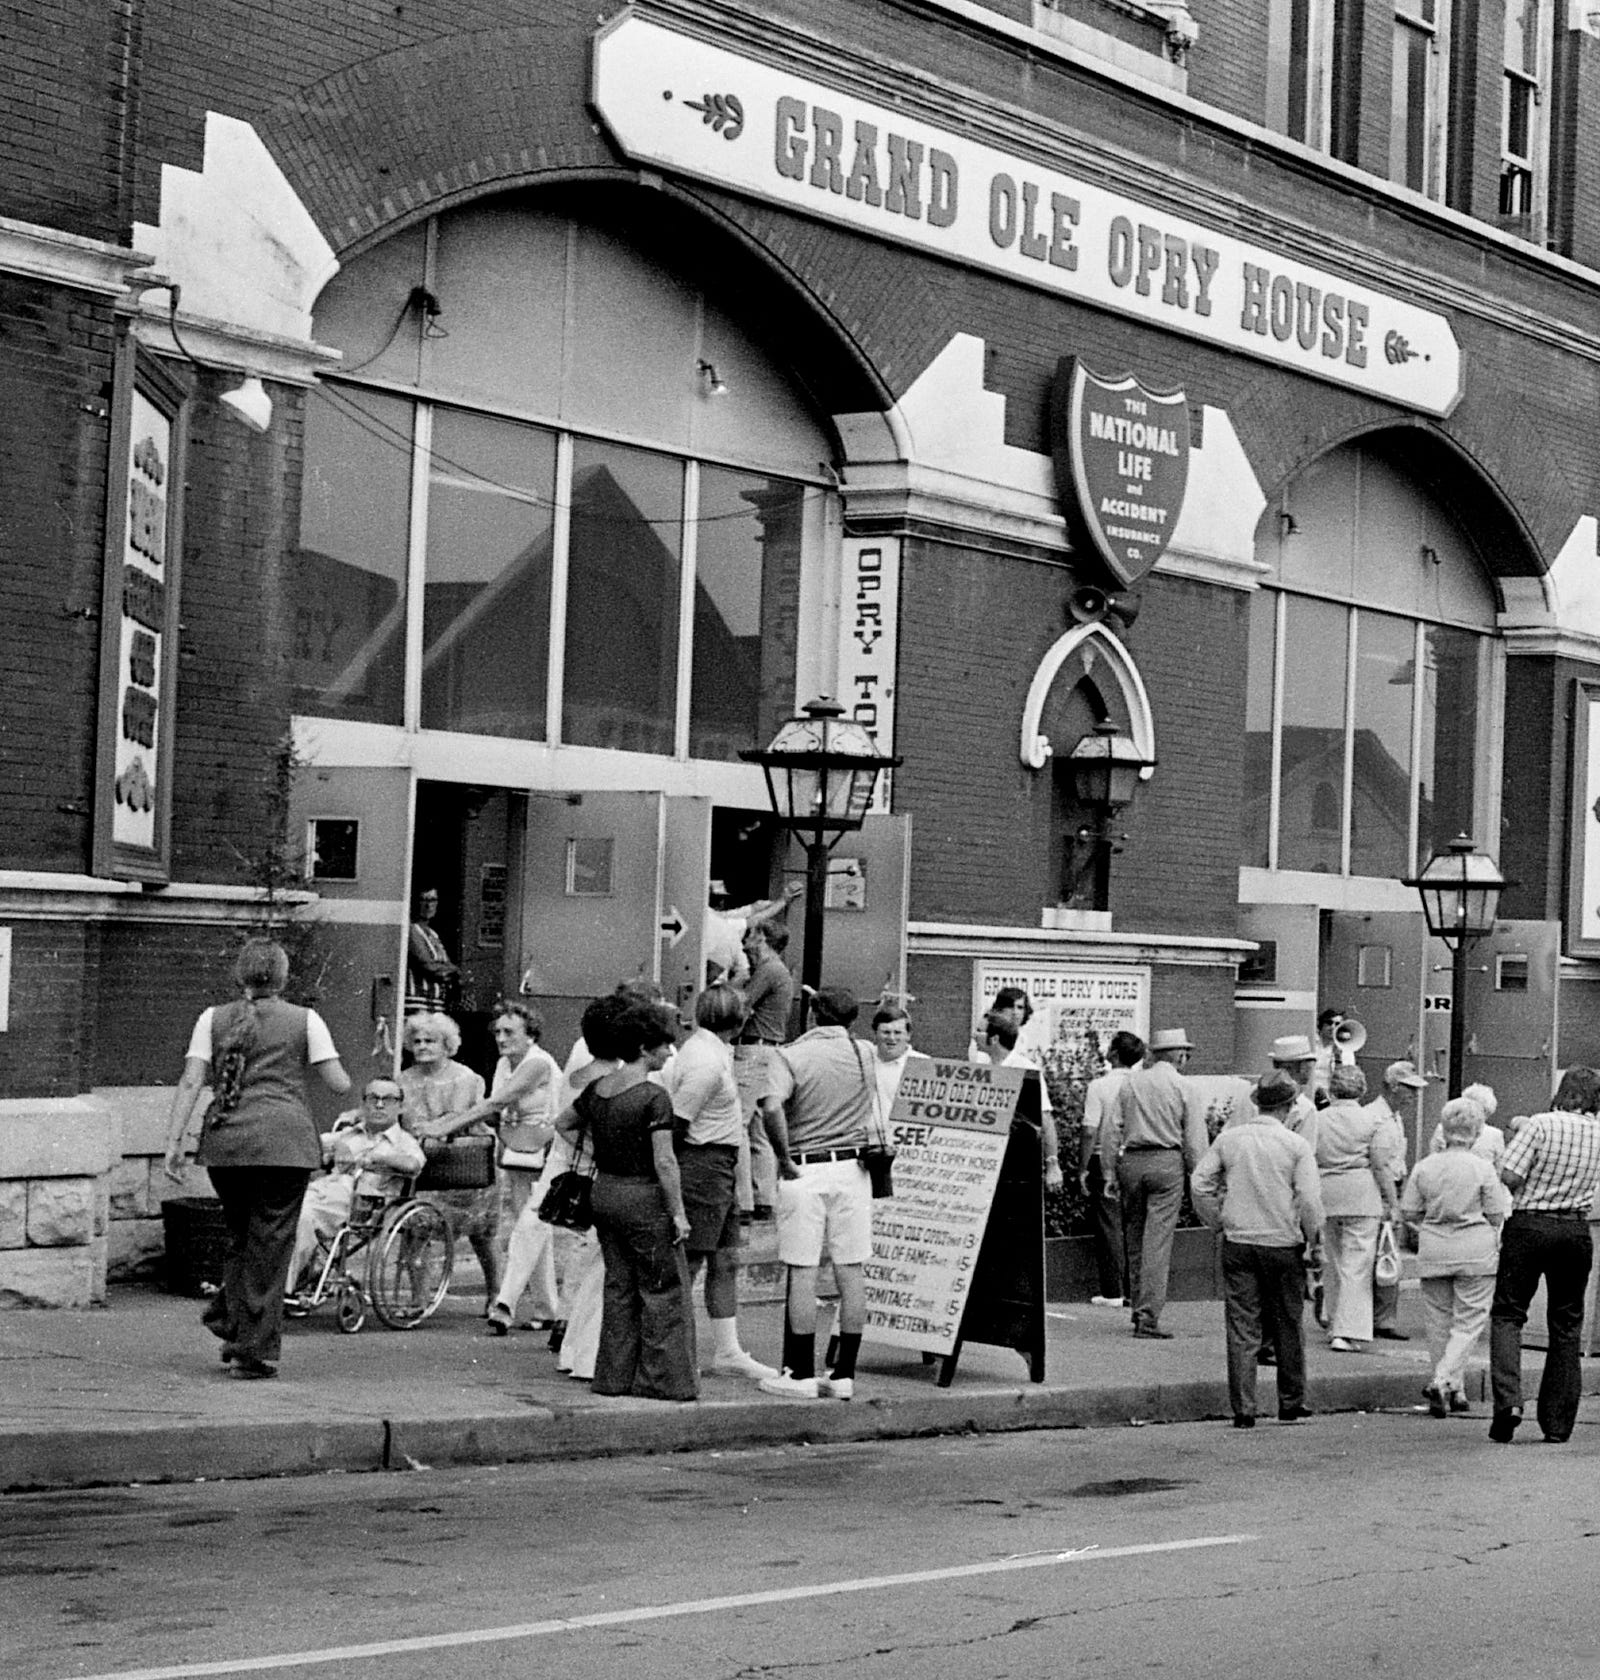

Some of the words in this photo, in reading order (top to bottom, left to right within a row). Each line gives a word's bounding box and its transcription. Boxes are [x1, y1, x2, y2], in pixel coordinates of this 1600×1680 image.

[775, 95, 959, 228] GRAND
[989, 172, 1081, 271] OLE
[1108, 215, 1220, 316] OPRY
[1240, 262, 1369, 368] HOUSE
[1125, 398, 1147, 416] THE
[1090, 411, 1179, 456] NATIONAL
[1118, 451, 1153, 481] LIFE
[1101, 498, 1167, 524] ACCIDENT
[1106, 525, 1161, 545] INSURANCE
[1127, 547, 1143, 560] CO.
[854, 548, 882, 655] OPRY
[1033, 978, 1056, 998] OLE
[1061, 979, 1095, 998] OPRY
[1099, 981, 1138, 999] TOURS
[935, 1063, 992, 1084] WSM
[899, 1077, 947, 1101] GRAND
[949, 1083, 976, 1104] OLE
[977, 1086, 1016, 1108] OPRY
[908, 1101, 997, 1126] TOURS
[893, 1126, 934, 1148] SEE!
[904, 1246, 931, 1265] FAME
[862, 1263, 897, 1283] SCENIC
